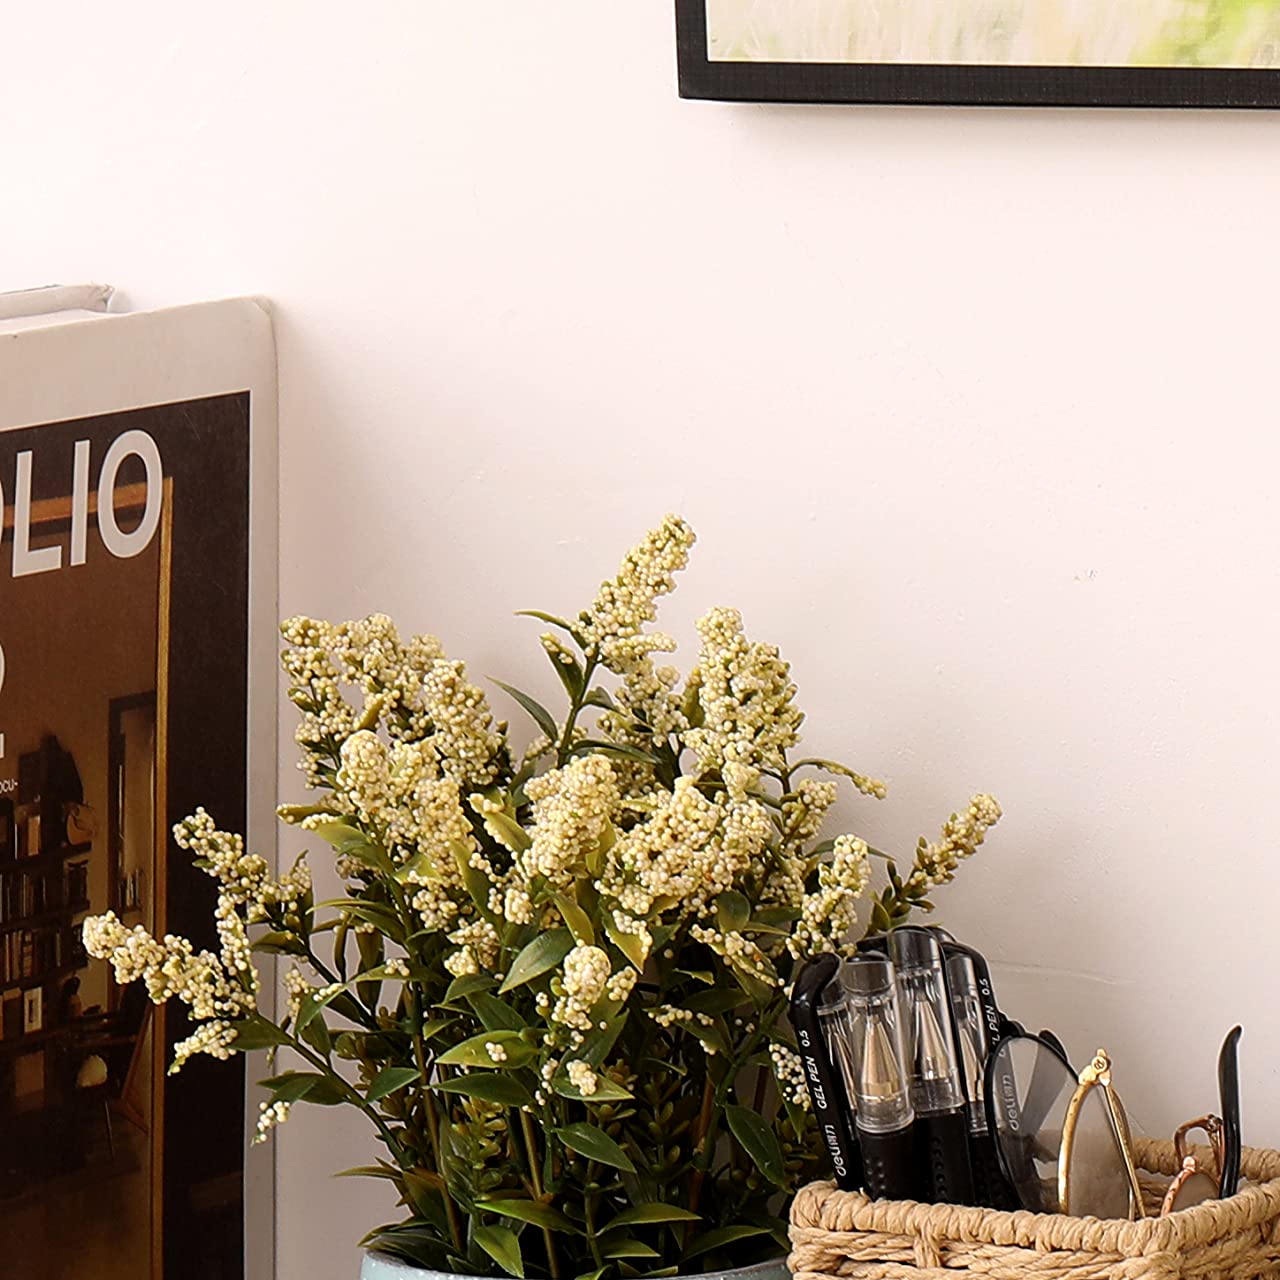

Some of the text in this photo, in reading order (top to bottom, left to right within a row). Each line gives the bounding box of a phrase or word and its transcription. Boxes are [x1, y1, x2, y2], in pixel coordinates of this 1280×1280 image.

[0, 429, 163, 578] LIO
[979, 977, 991, 996] 0.5
[984, 1004, 999, 1034] PEN
[799, 1030, 828, 1110] GEL PEN 0.5
